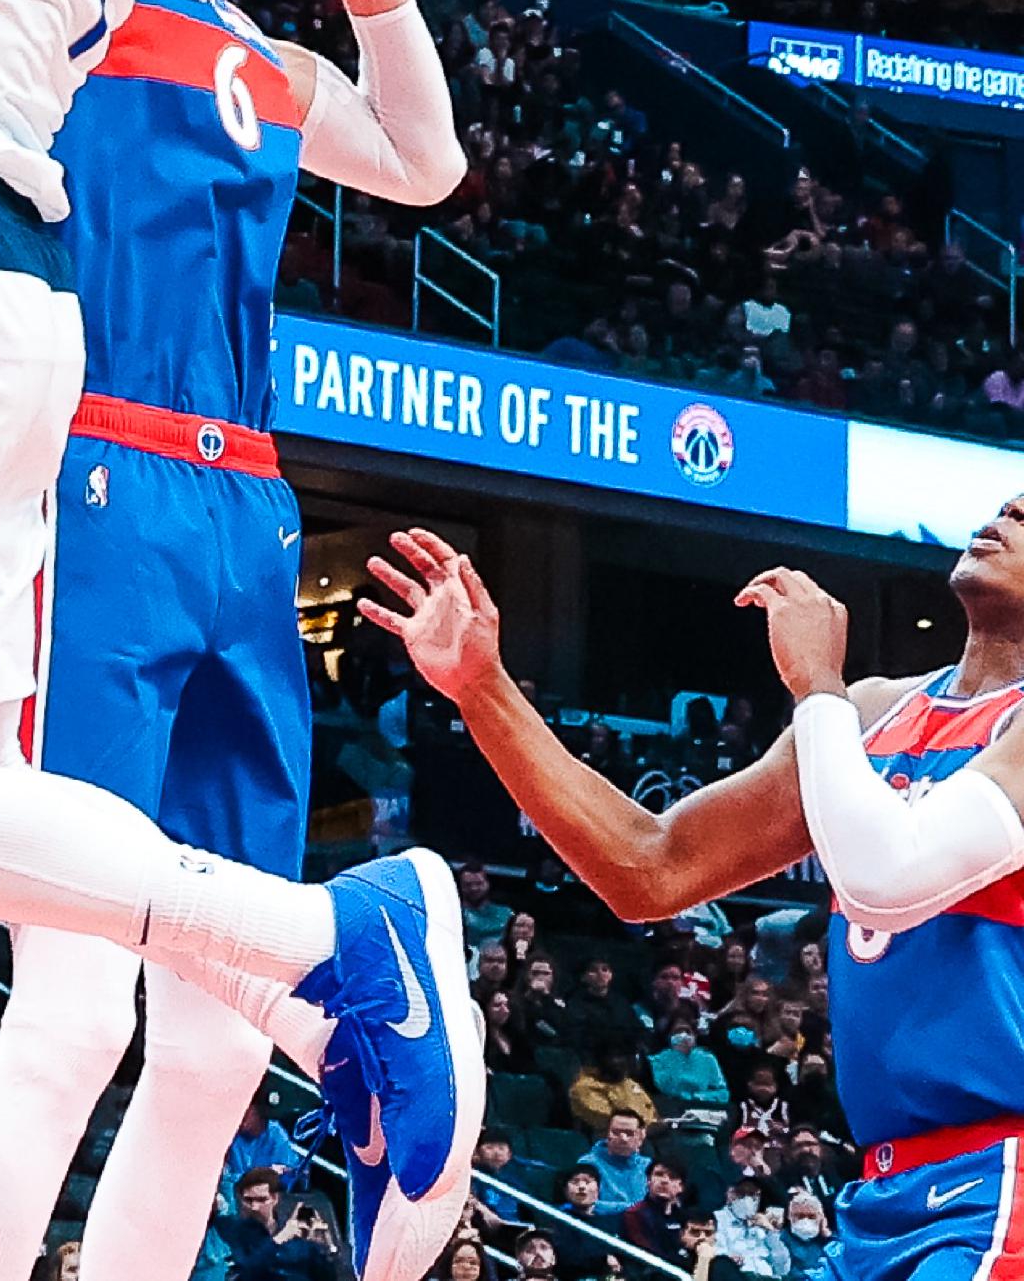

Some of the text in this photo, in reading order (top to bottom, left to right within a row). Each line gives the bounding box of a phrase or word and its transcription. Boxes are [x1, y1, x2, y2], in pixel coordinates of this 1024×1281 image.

[214, 42, 263, 152] 6
[866, 48, 952, 91] Redefining
[953, 60, 981, 94] the
[293, 344, 640, 464] PARTNER OF THE
